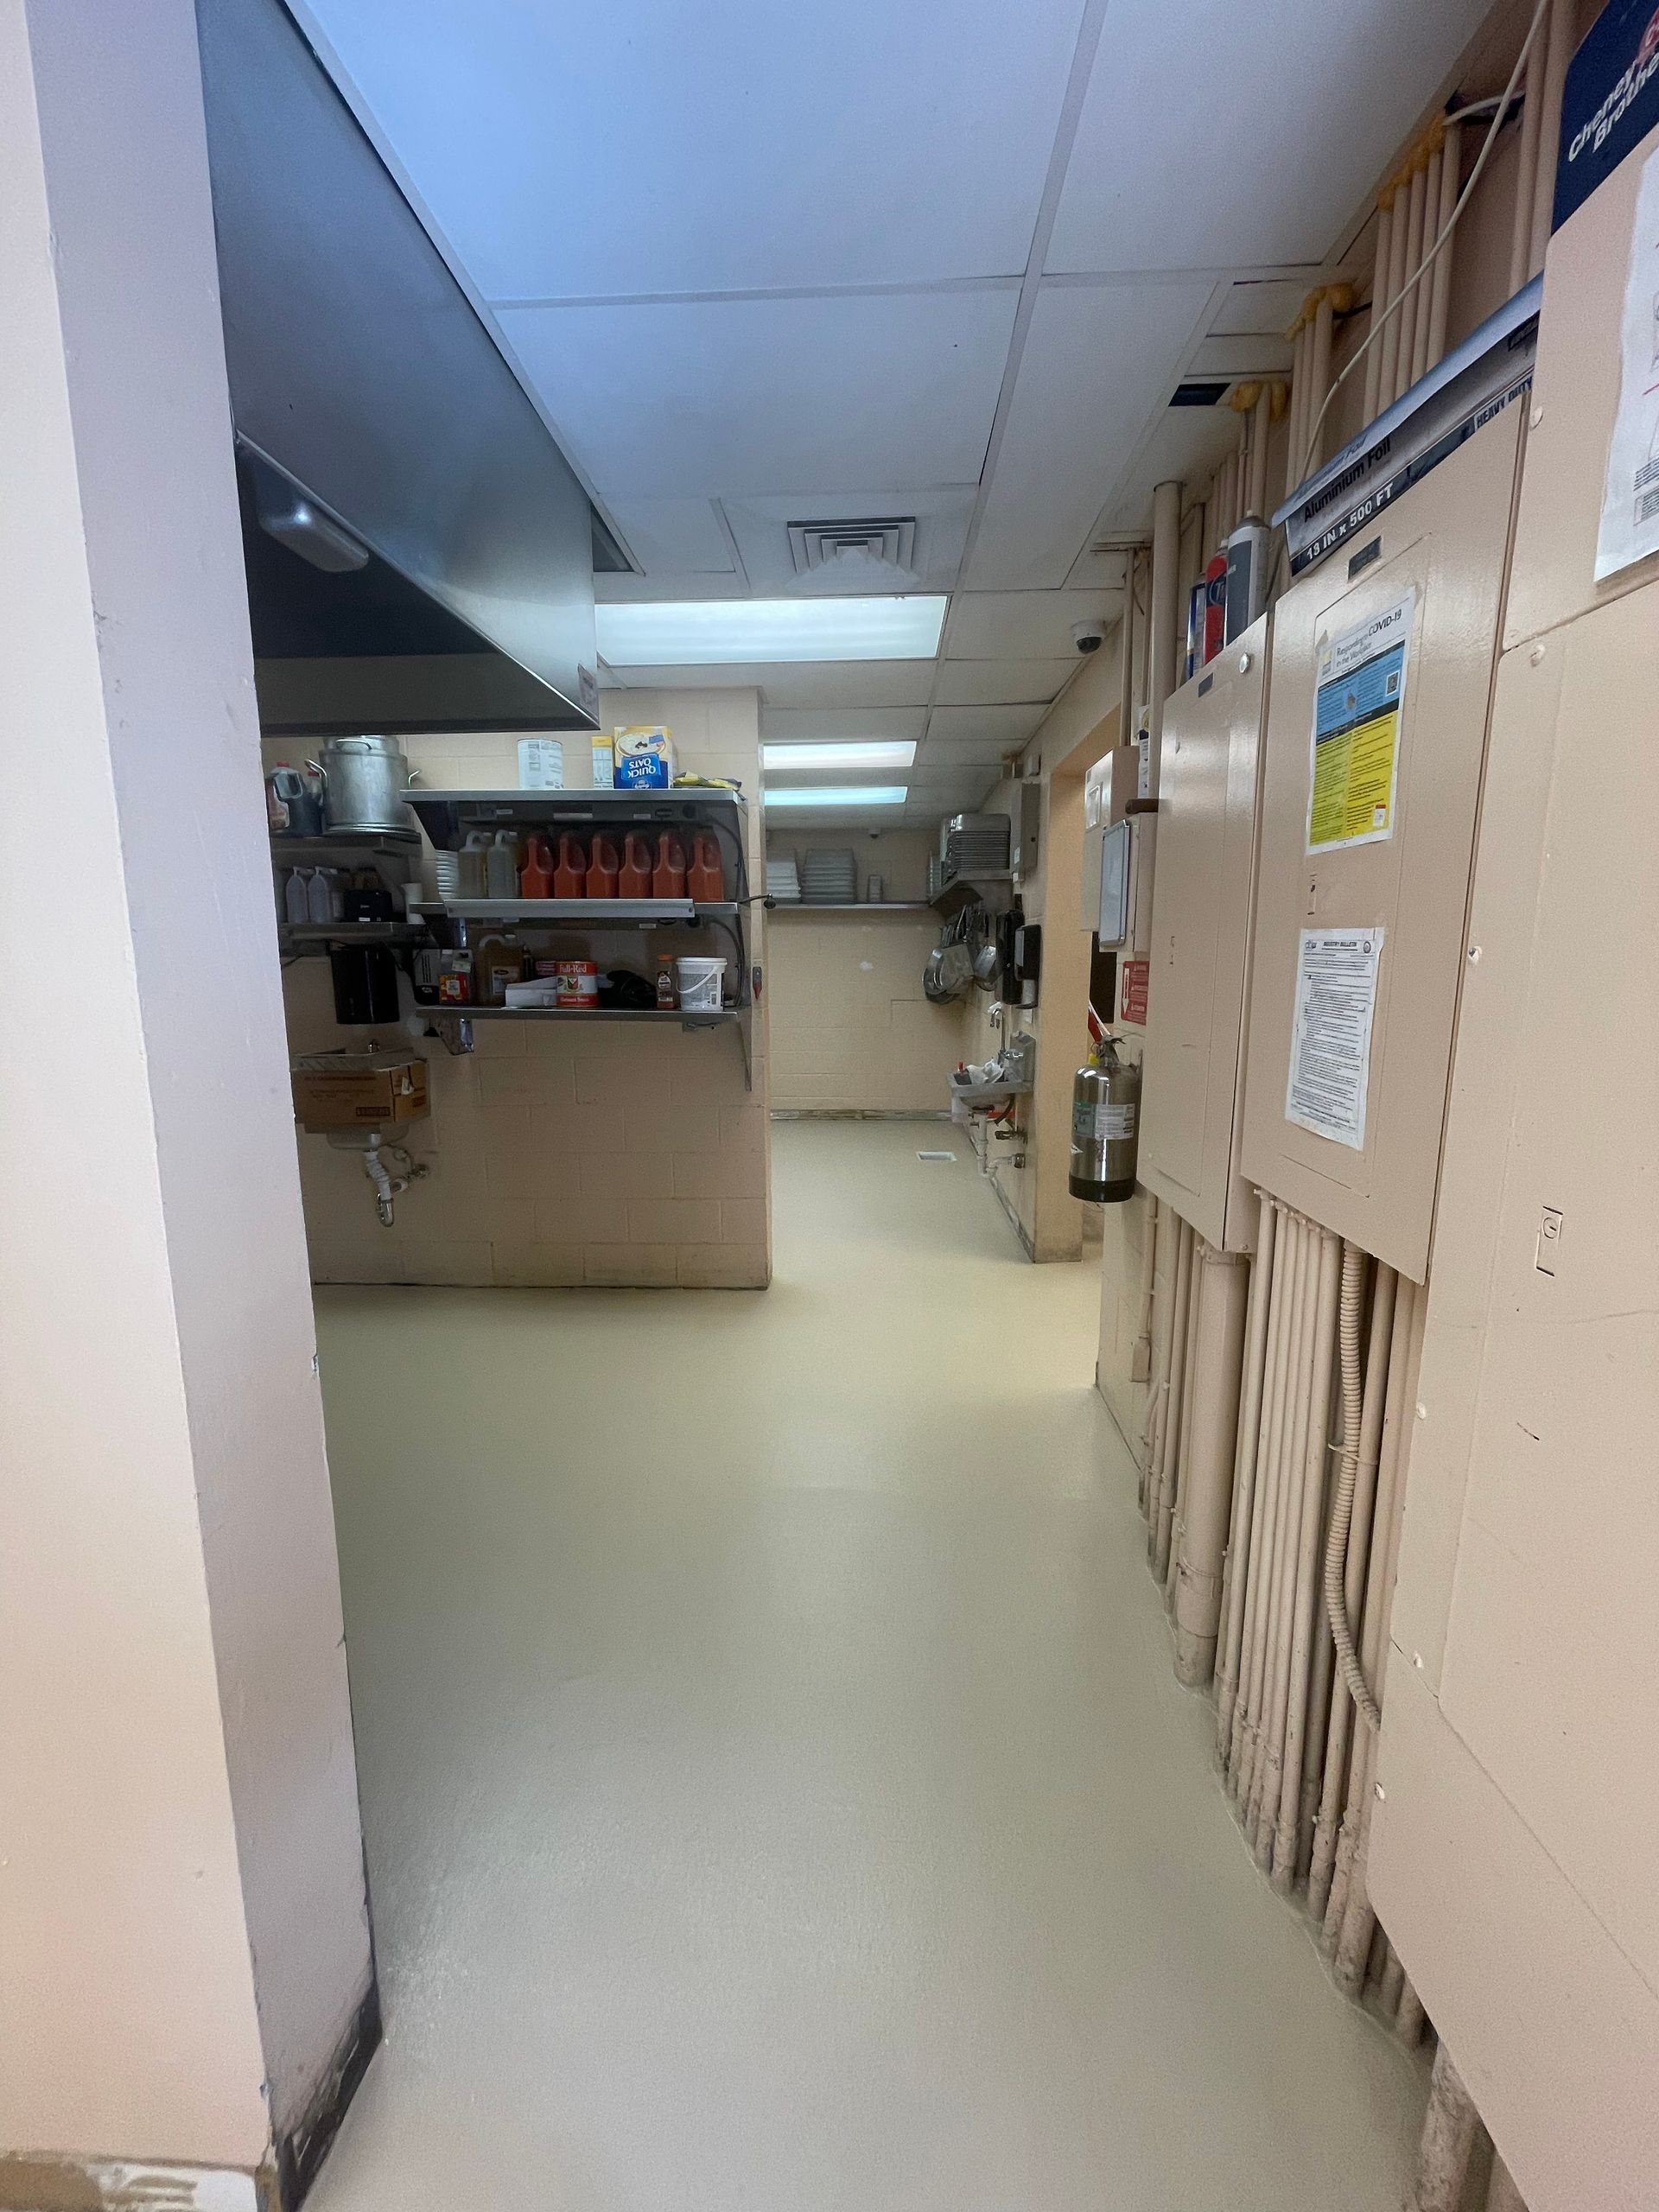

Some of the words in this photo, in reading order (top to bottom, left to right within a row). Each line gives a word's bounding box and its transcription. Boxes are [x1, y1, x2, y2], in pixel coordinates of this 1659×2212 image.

[1568, 59, 1636, 162] Cheney
[1476, 396, 1505, 429] HEAVY
[1508, 376, 1533, 404] DUTY
[1304, 461, 1364, 522] Aluminium
[1368, 435, 1391, 468] Foil
[1323, 531, 1337, 550] IN
[1350, 500, 1372, 527] 500
[1376, 482, 1394, 507] FT
[1368, 608, 1402, 638] COVID-19
[628, 766, 657, 779] QUICK
[629, 758, 652, 770] OATS
